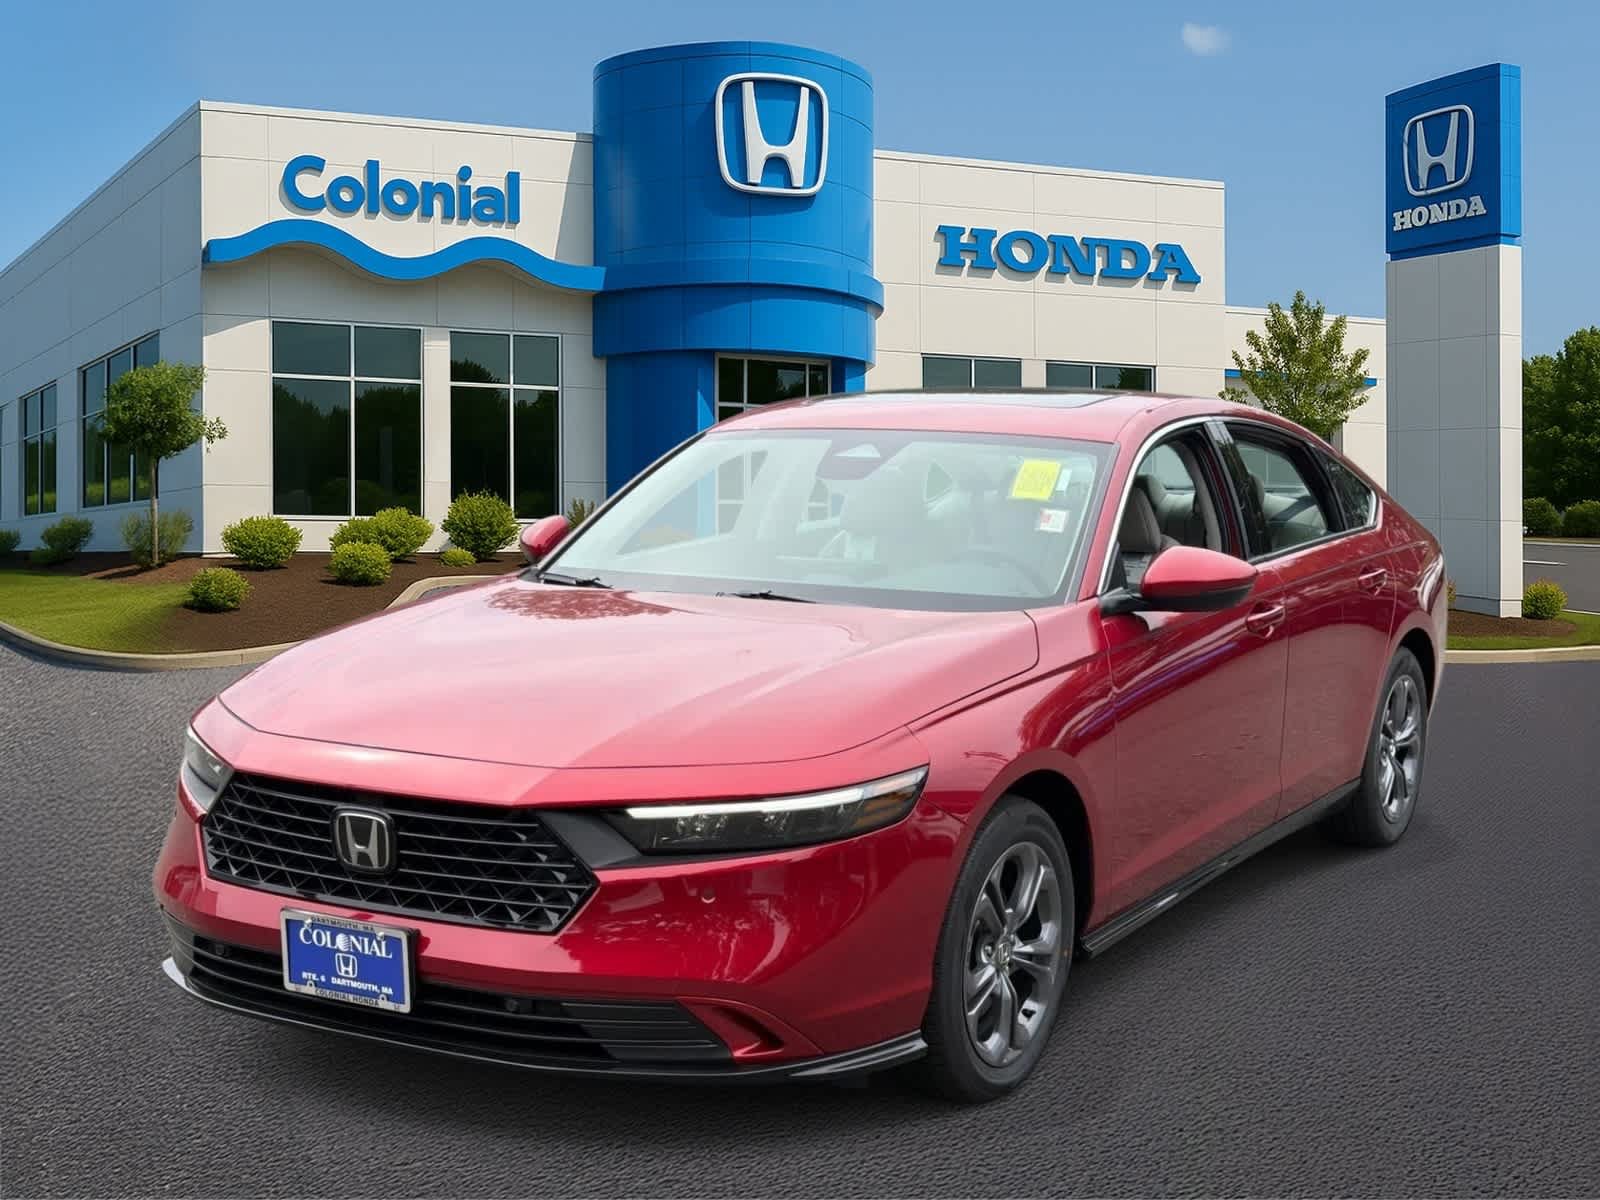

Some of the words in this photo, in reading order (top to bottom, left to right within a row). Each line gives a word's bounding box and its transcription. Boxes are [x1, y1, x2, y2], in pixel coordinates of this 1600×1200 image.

[281, 154, 521, 226] Colonial
[1393, 195, 1487, 231] HONDA
[936, 224, 1201, 285] HONDA
[300, 926, 393, 959] COLONIAL
[315, 988, 351, 999] COLONIAL
[352, 996, 379, 1006] HONDA
[381, 986, 394, 995] MA
